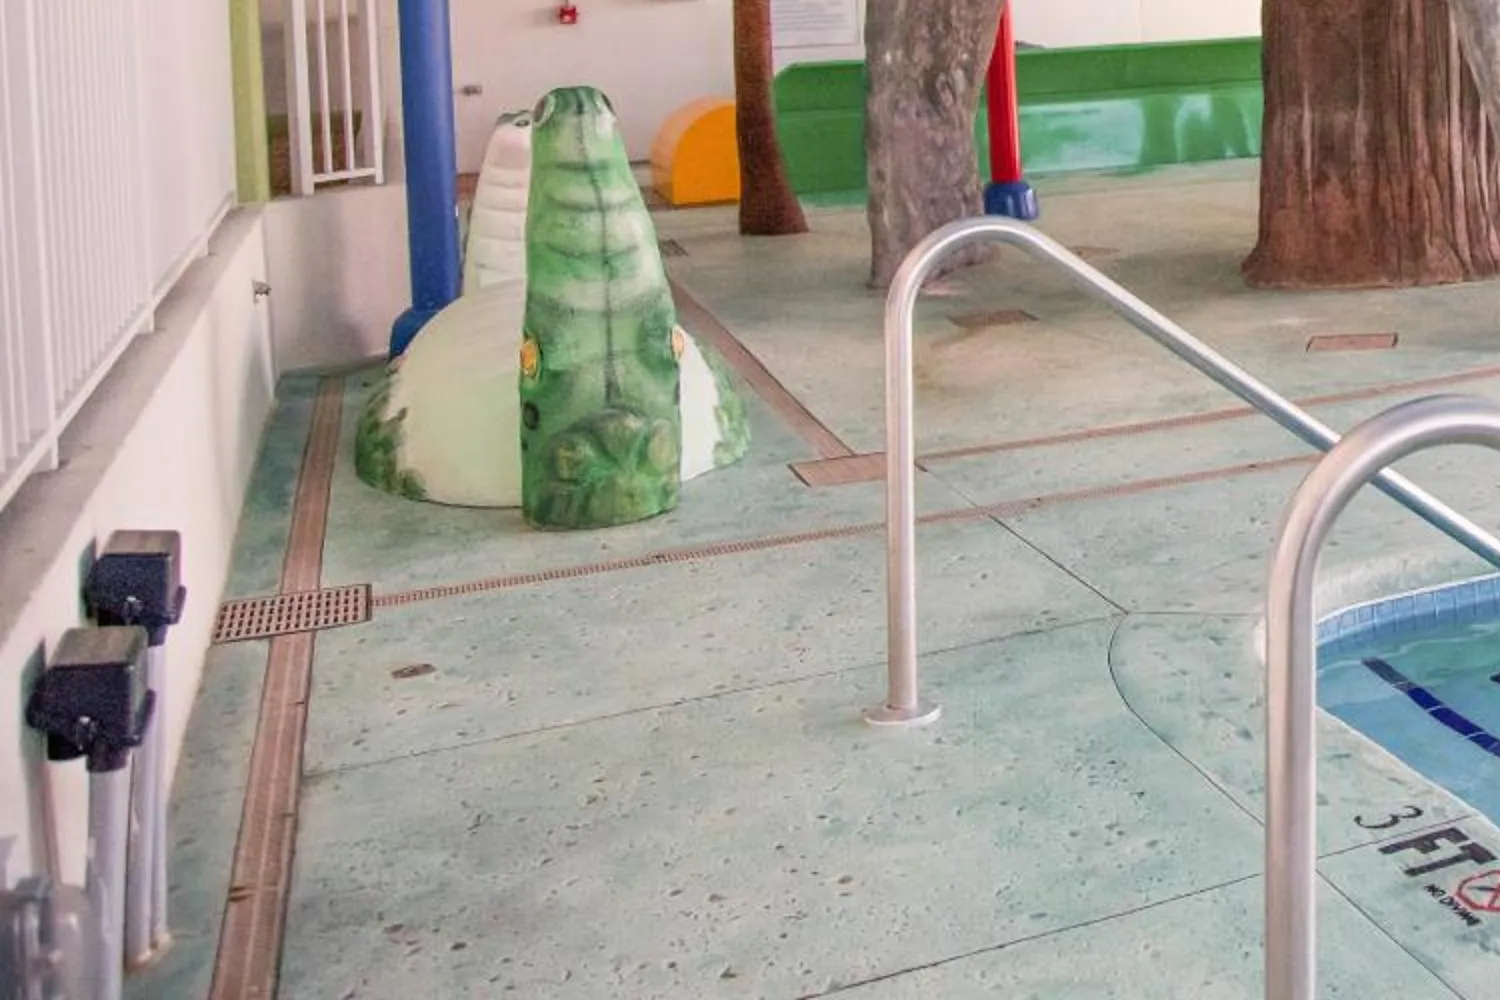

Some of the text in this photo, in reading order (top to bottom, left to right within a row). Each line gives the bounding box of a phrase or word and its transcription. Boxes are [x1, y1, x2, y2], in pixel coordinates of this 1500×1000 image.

[1353, 804, 1499, 877] 3 FT
[1424, 883, 1447, 899] NO
